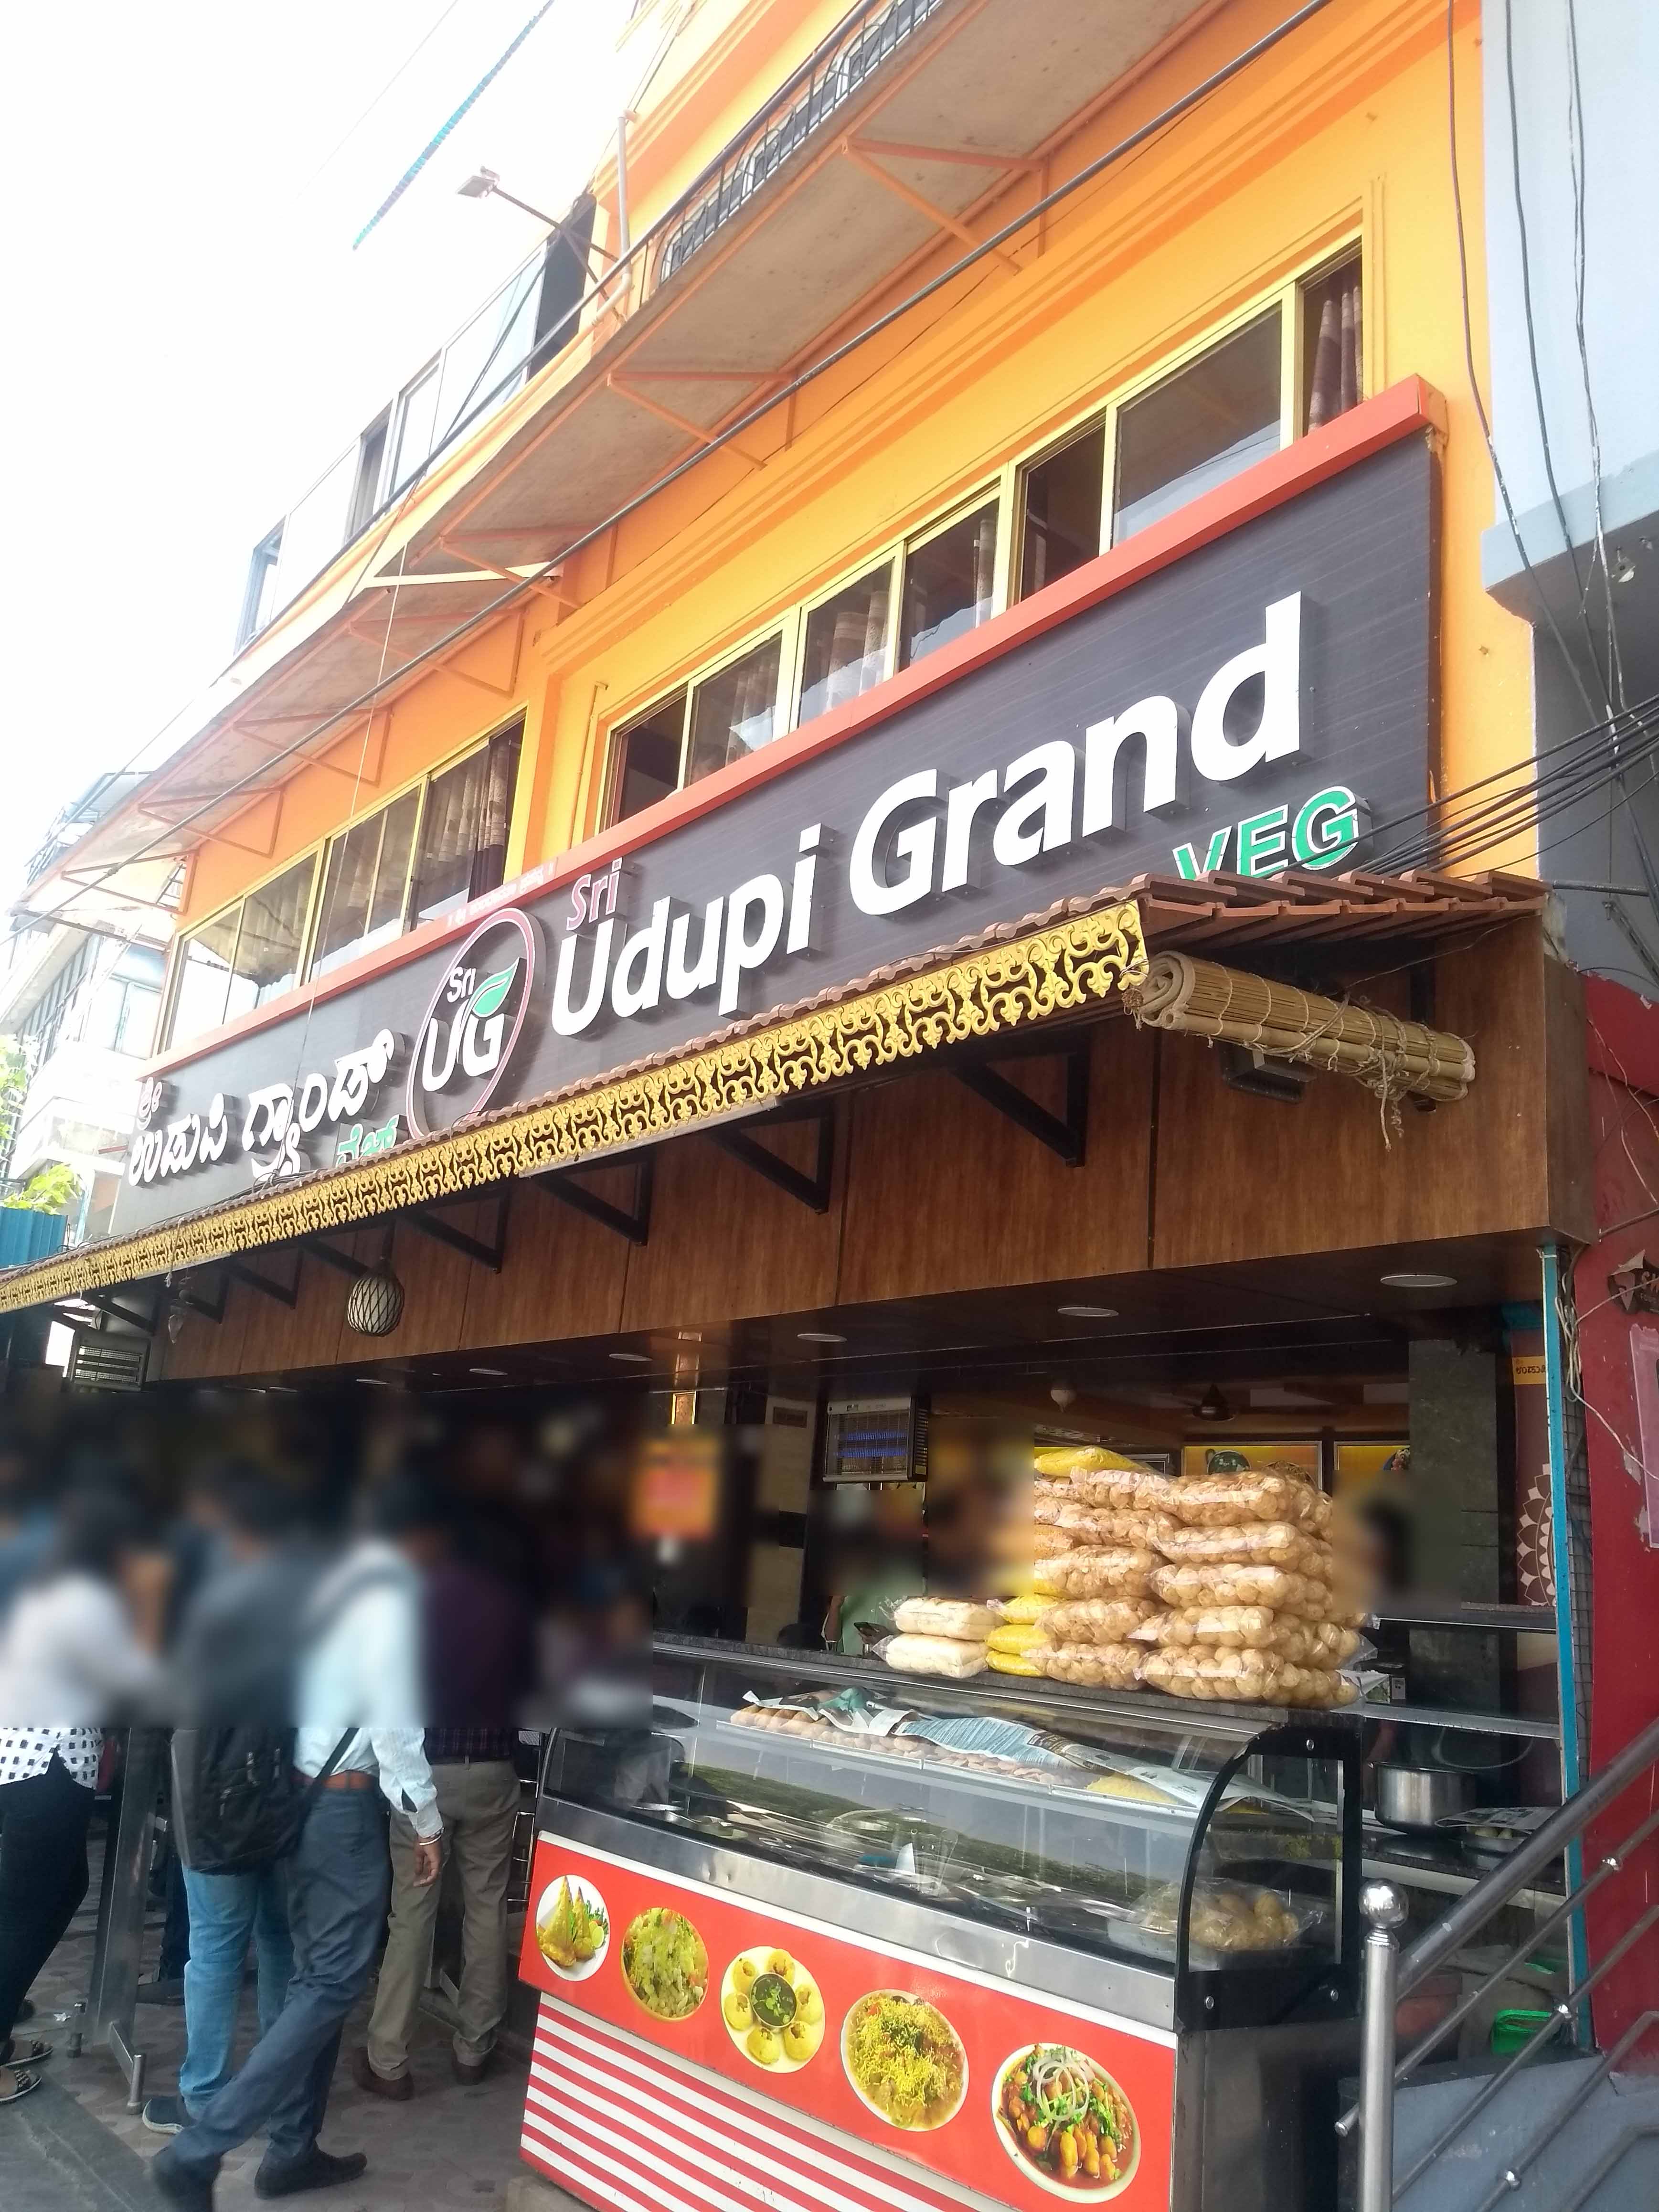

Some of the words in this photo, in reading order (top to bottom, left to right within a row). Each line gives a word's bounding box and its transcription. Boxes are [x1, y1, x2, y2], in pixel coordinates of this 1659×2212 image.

[552, 823, 821, 1035] Udupi
[850, 591, 1301, 915] Grand
[1172, 786, 1359, 881] VEG
[566, 857, 623, 931] Sri
[423, 999, 504, 1091] UG
[128, 1093, 228, 1186] ಉಡುಪಿ
[137, 1076, 162, 1130] ಶ್ರೀ
